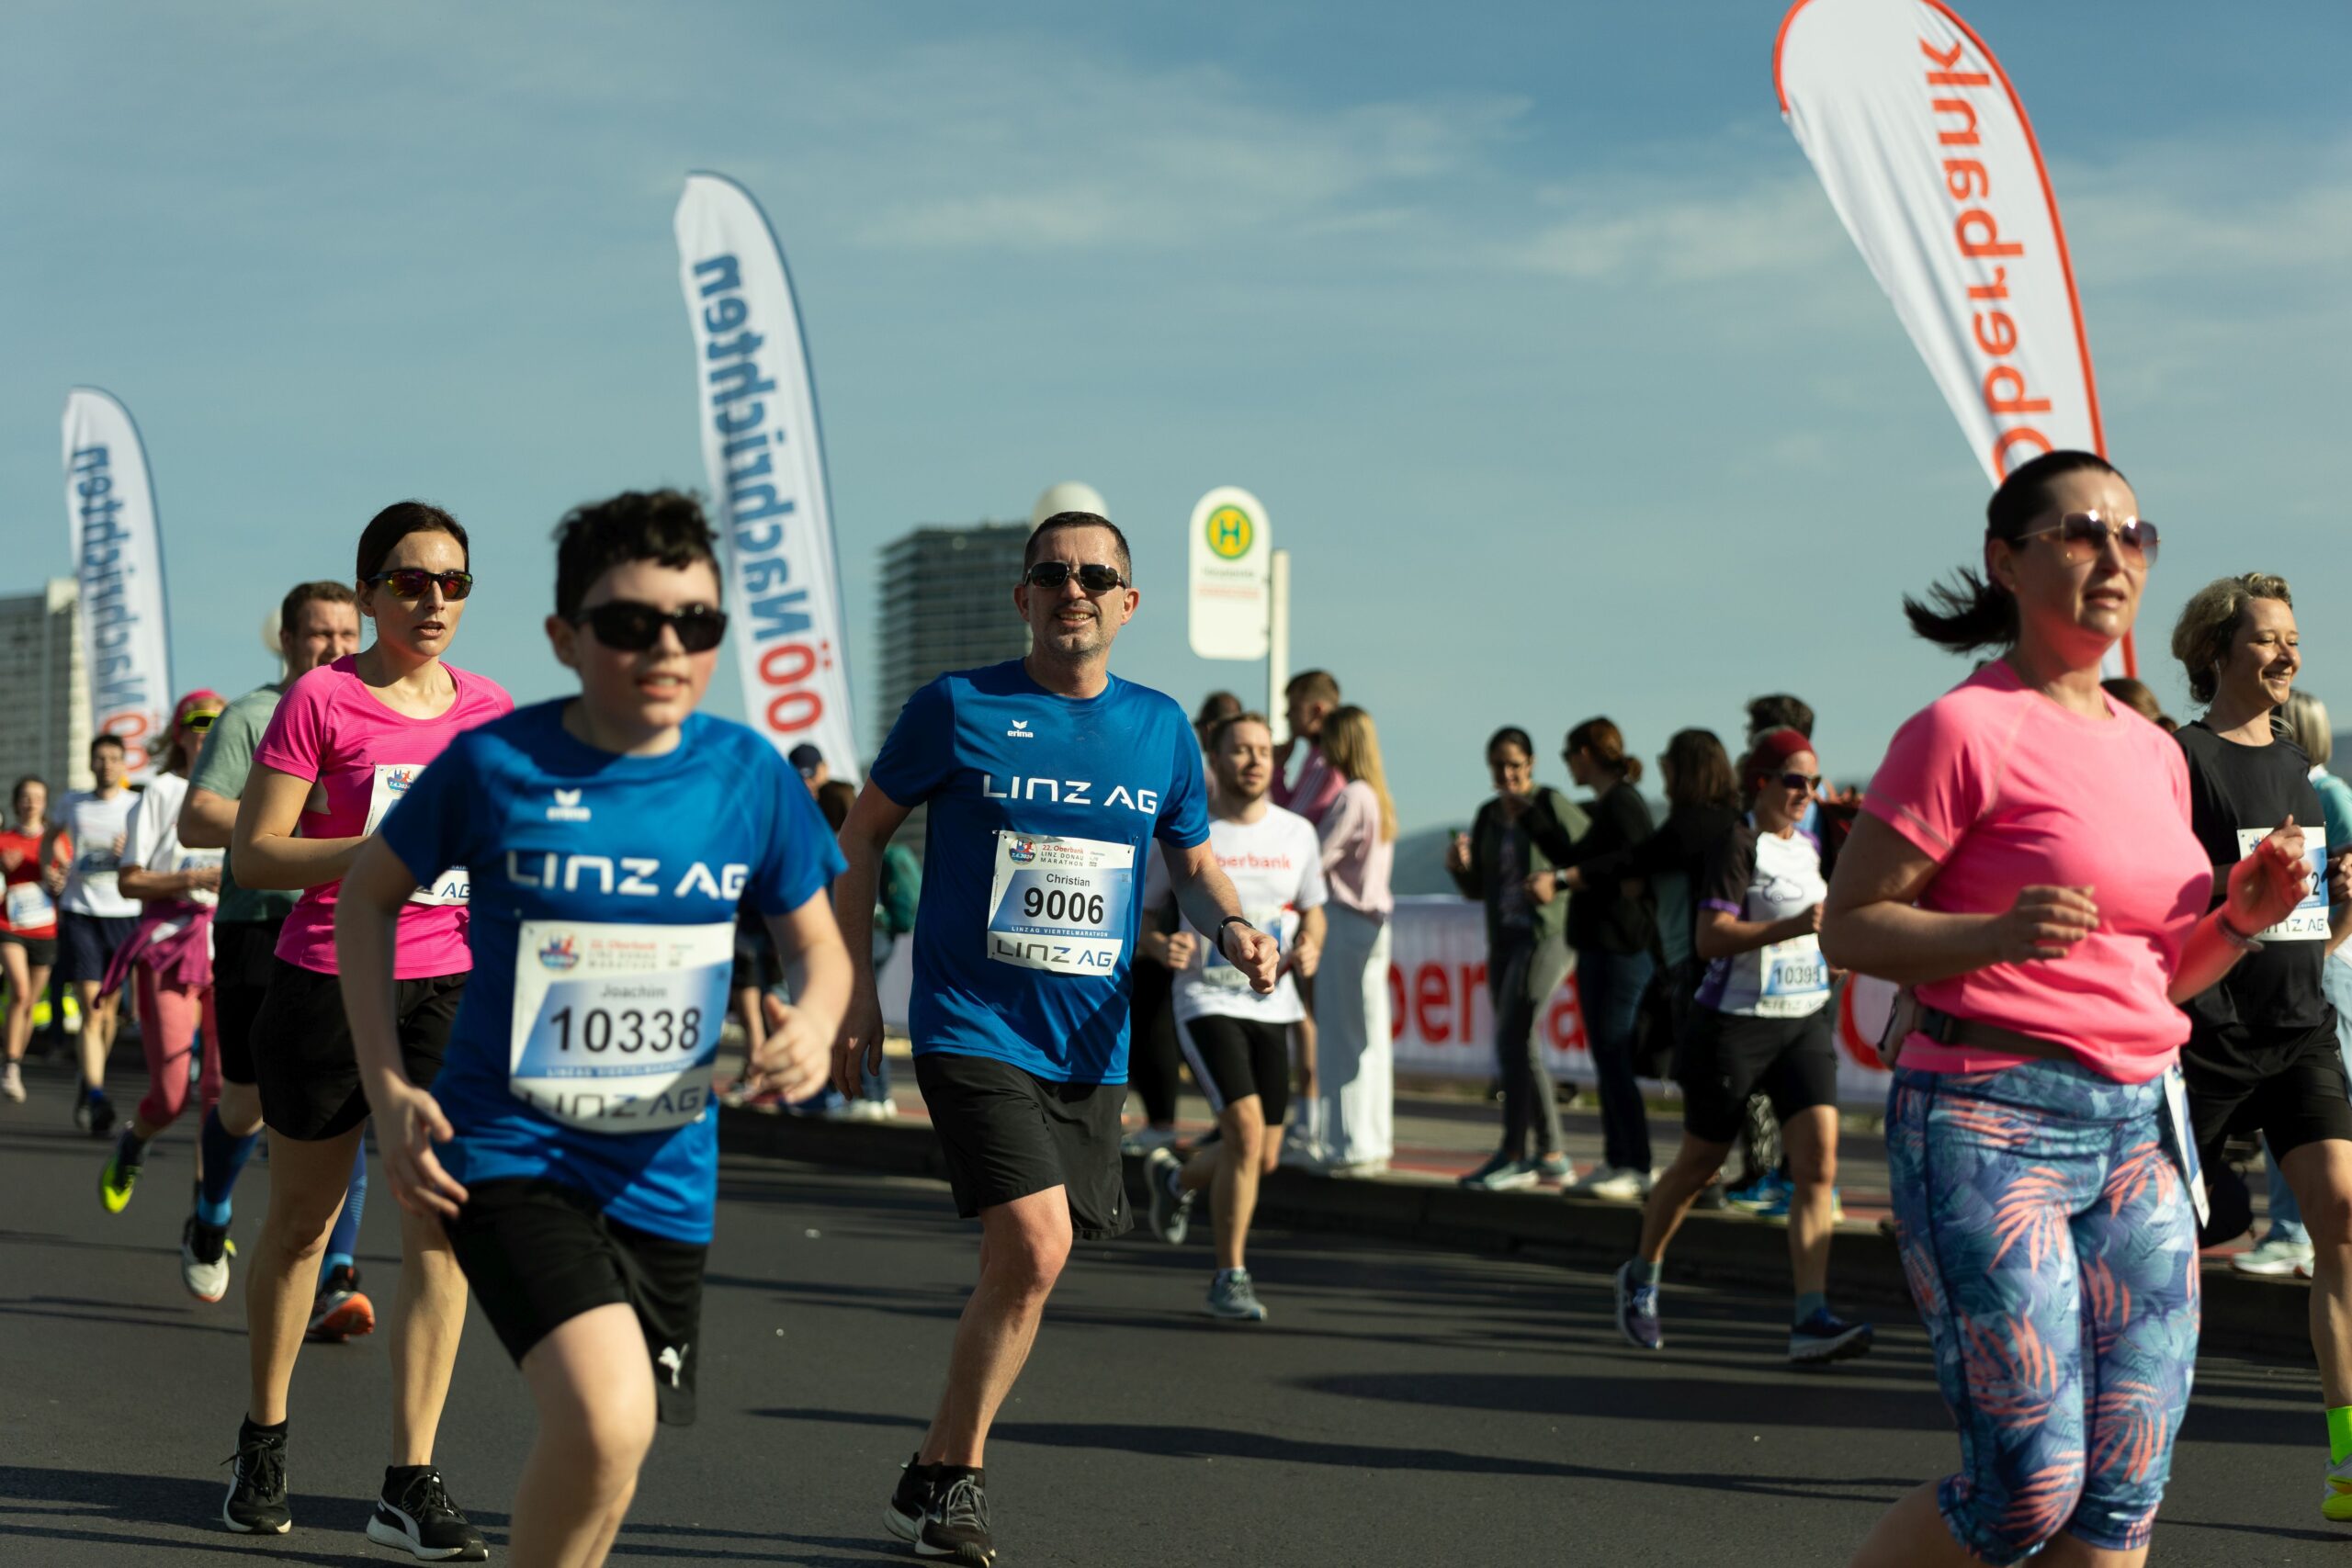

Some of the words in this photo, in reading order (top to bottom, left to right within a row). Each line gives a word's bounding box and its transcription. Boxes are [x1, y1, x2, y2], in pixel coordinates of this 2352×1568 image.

[1007, 729, 1035, 739] erima
[983, 774, 1091, 805] LINZ
[1103, 785, 1158, 815] AG
[1053, 845, 1084, 854] Oberbank
[1215, 852, 1291, 869] berbank
[1040, 857, 1084, 867] MARATHON
[506, 850, 660, 896] LINZ
[673, 861, 750, 900] AG
[1046, 874, 1091, 887] Christian
[1023, 886, 1104, 924] 9006
[2307, 919, 2324, 931] AG
[997, 940, 1071, 964] LINZ
[1077, 950, 1113, 967] AG
[550, 1005, 701, 1053] 10338
[648, 1087, 701, 1116] AG
